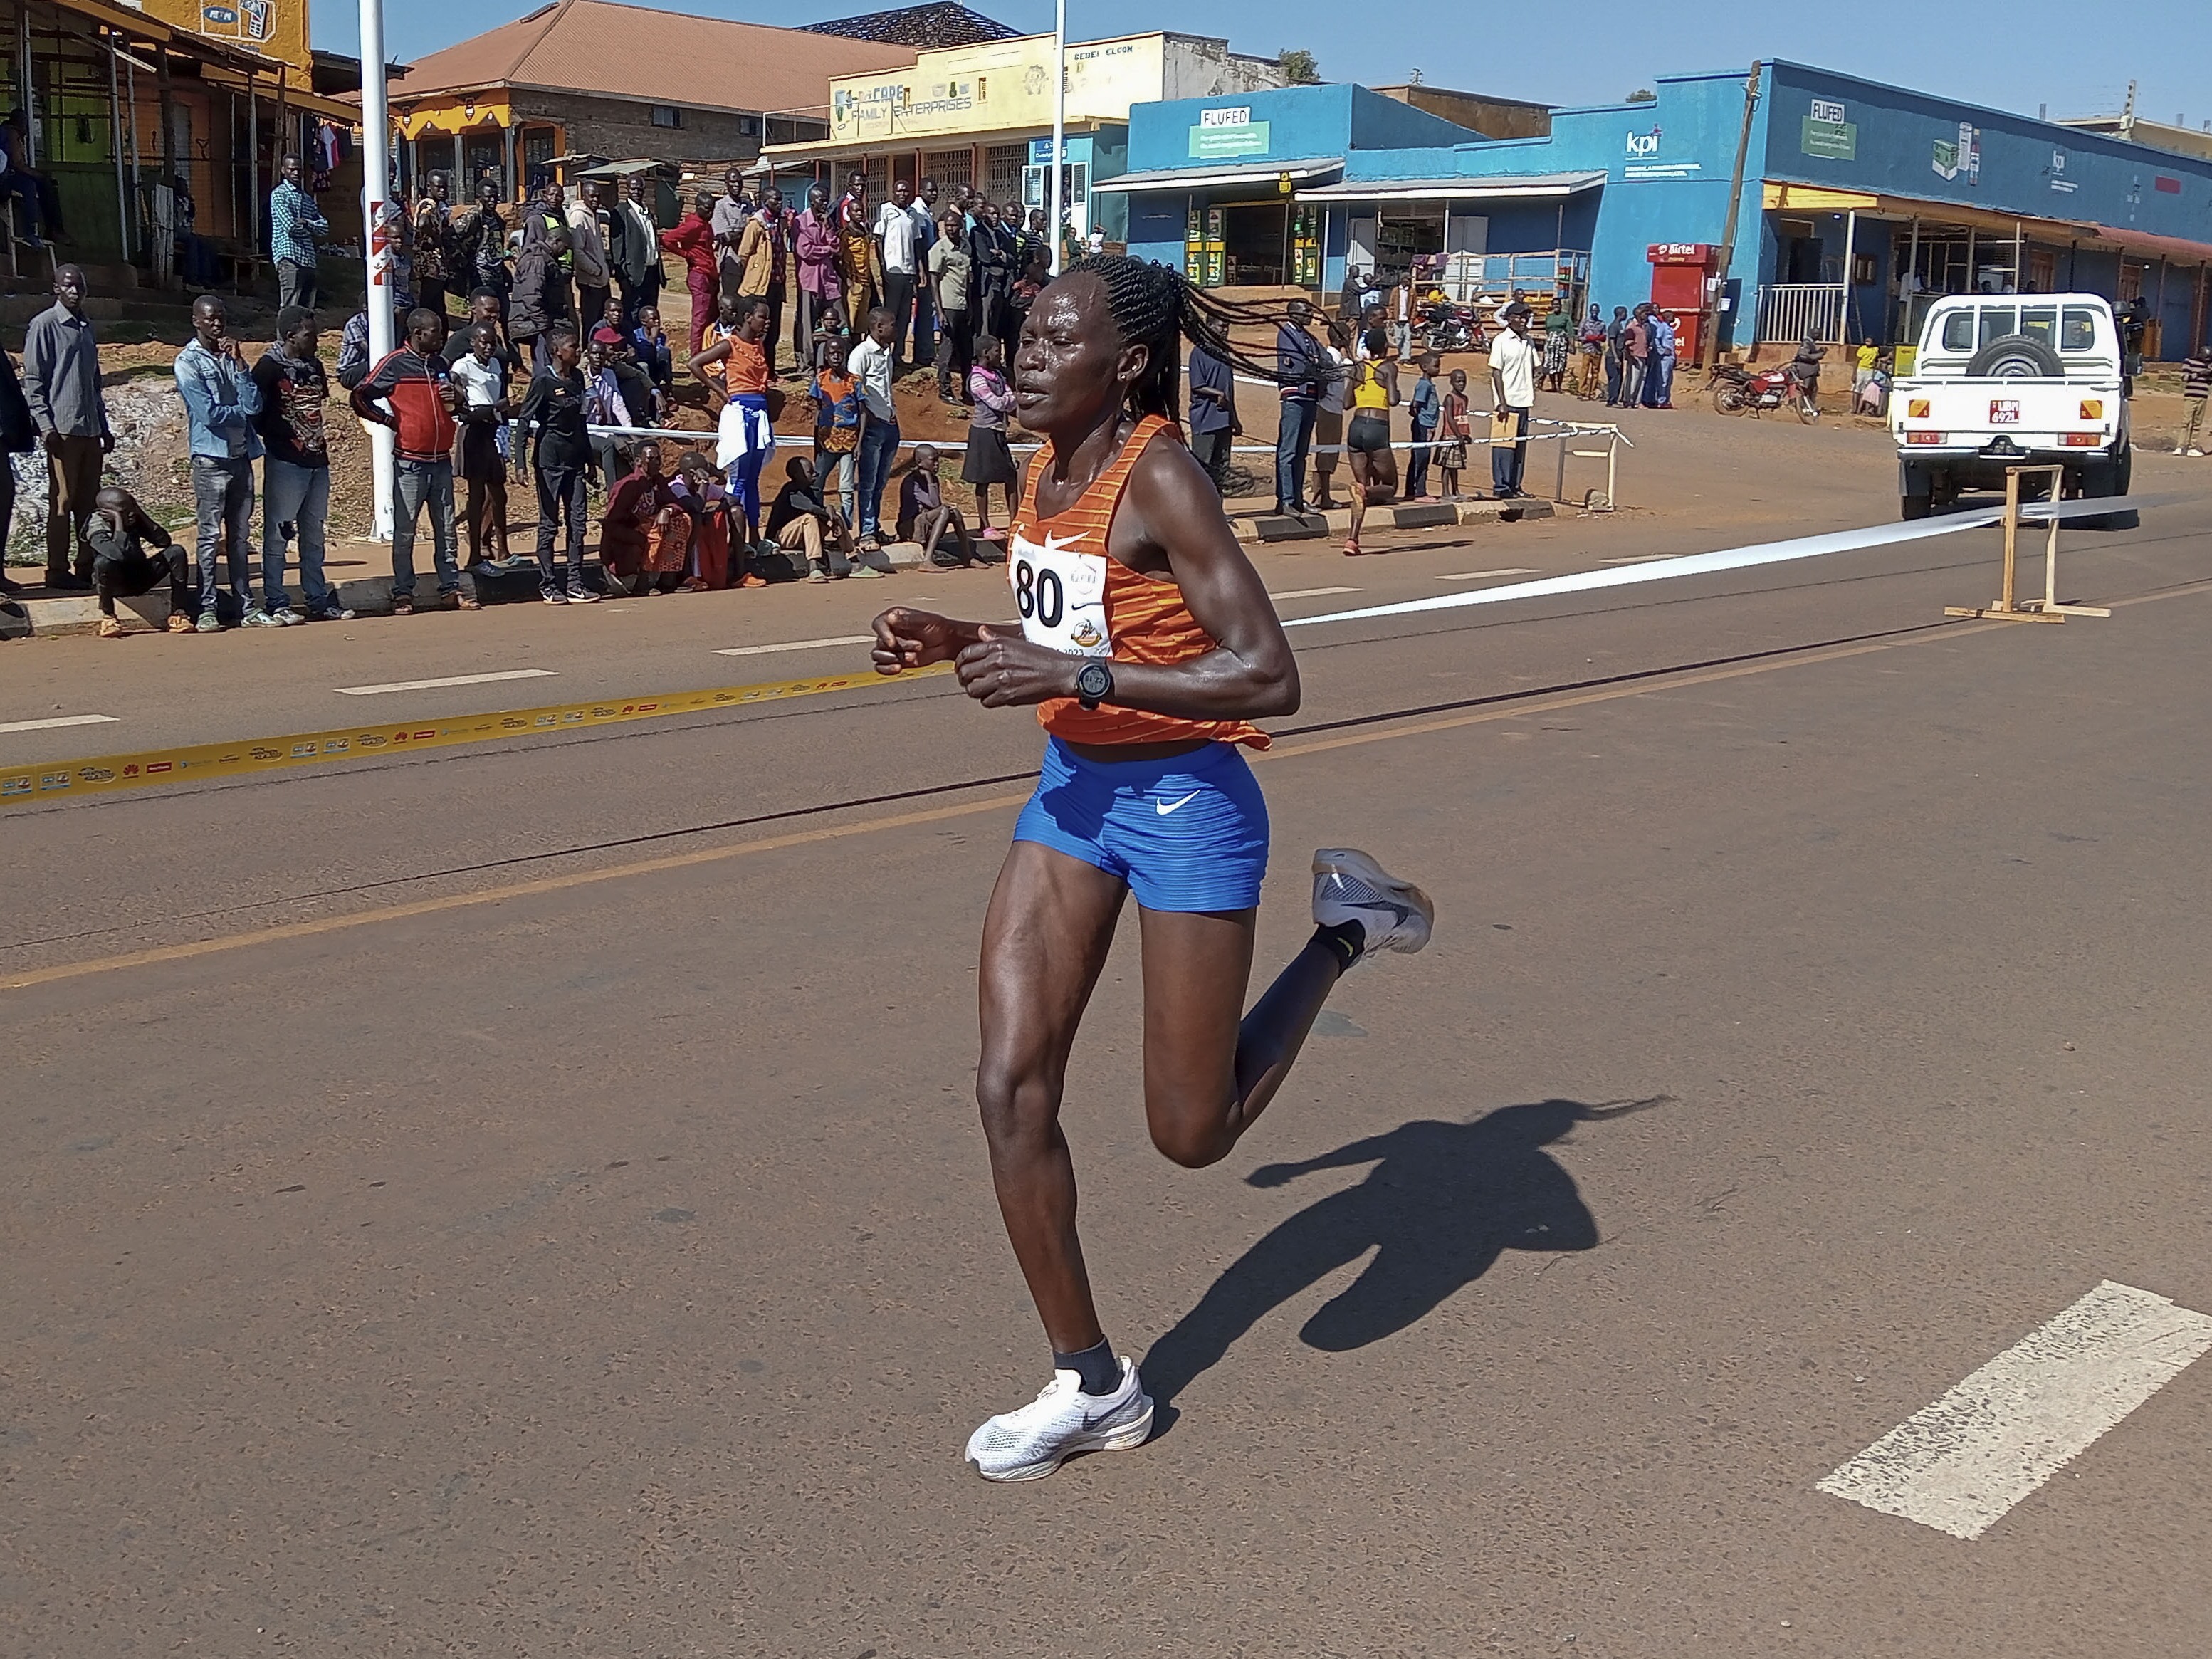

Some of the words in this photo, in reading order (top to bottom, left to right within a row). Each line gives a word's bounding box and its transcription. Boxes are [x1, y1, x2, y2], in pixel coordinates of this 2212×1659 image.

[851, 107, 888, 122] FAMILY
[893, 97, 972, 117] ENTERPRISES
[1204, 110, 1247, 125] FLUFED
[1813, 103, 1843, 122] FLUFED
[1626, 131, 1659, 157] kpi
[1668, 244, 1695, 254] airtel
[1991, 411, 2019, 423] 692L
[1016, 559, 1064, 628] 80
